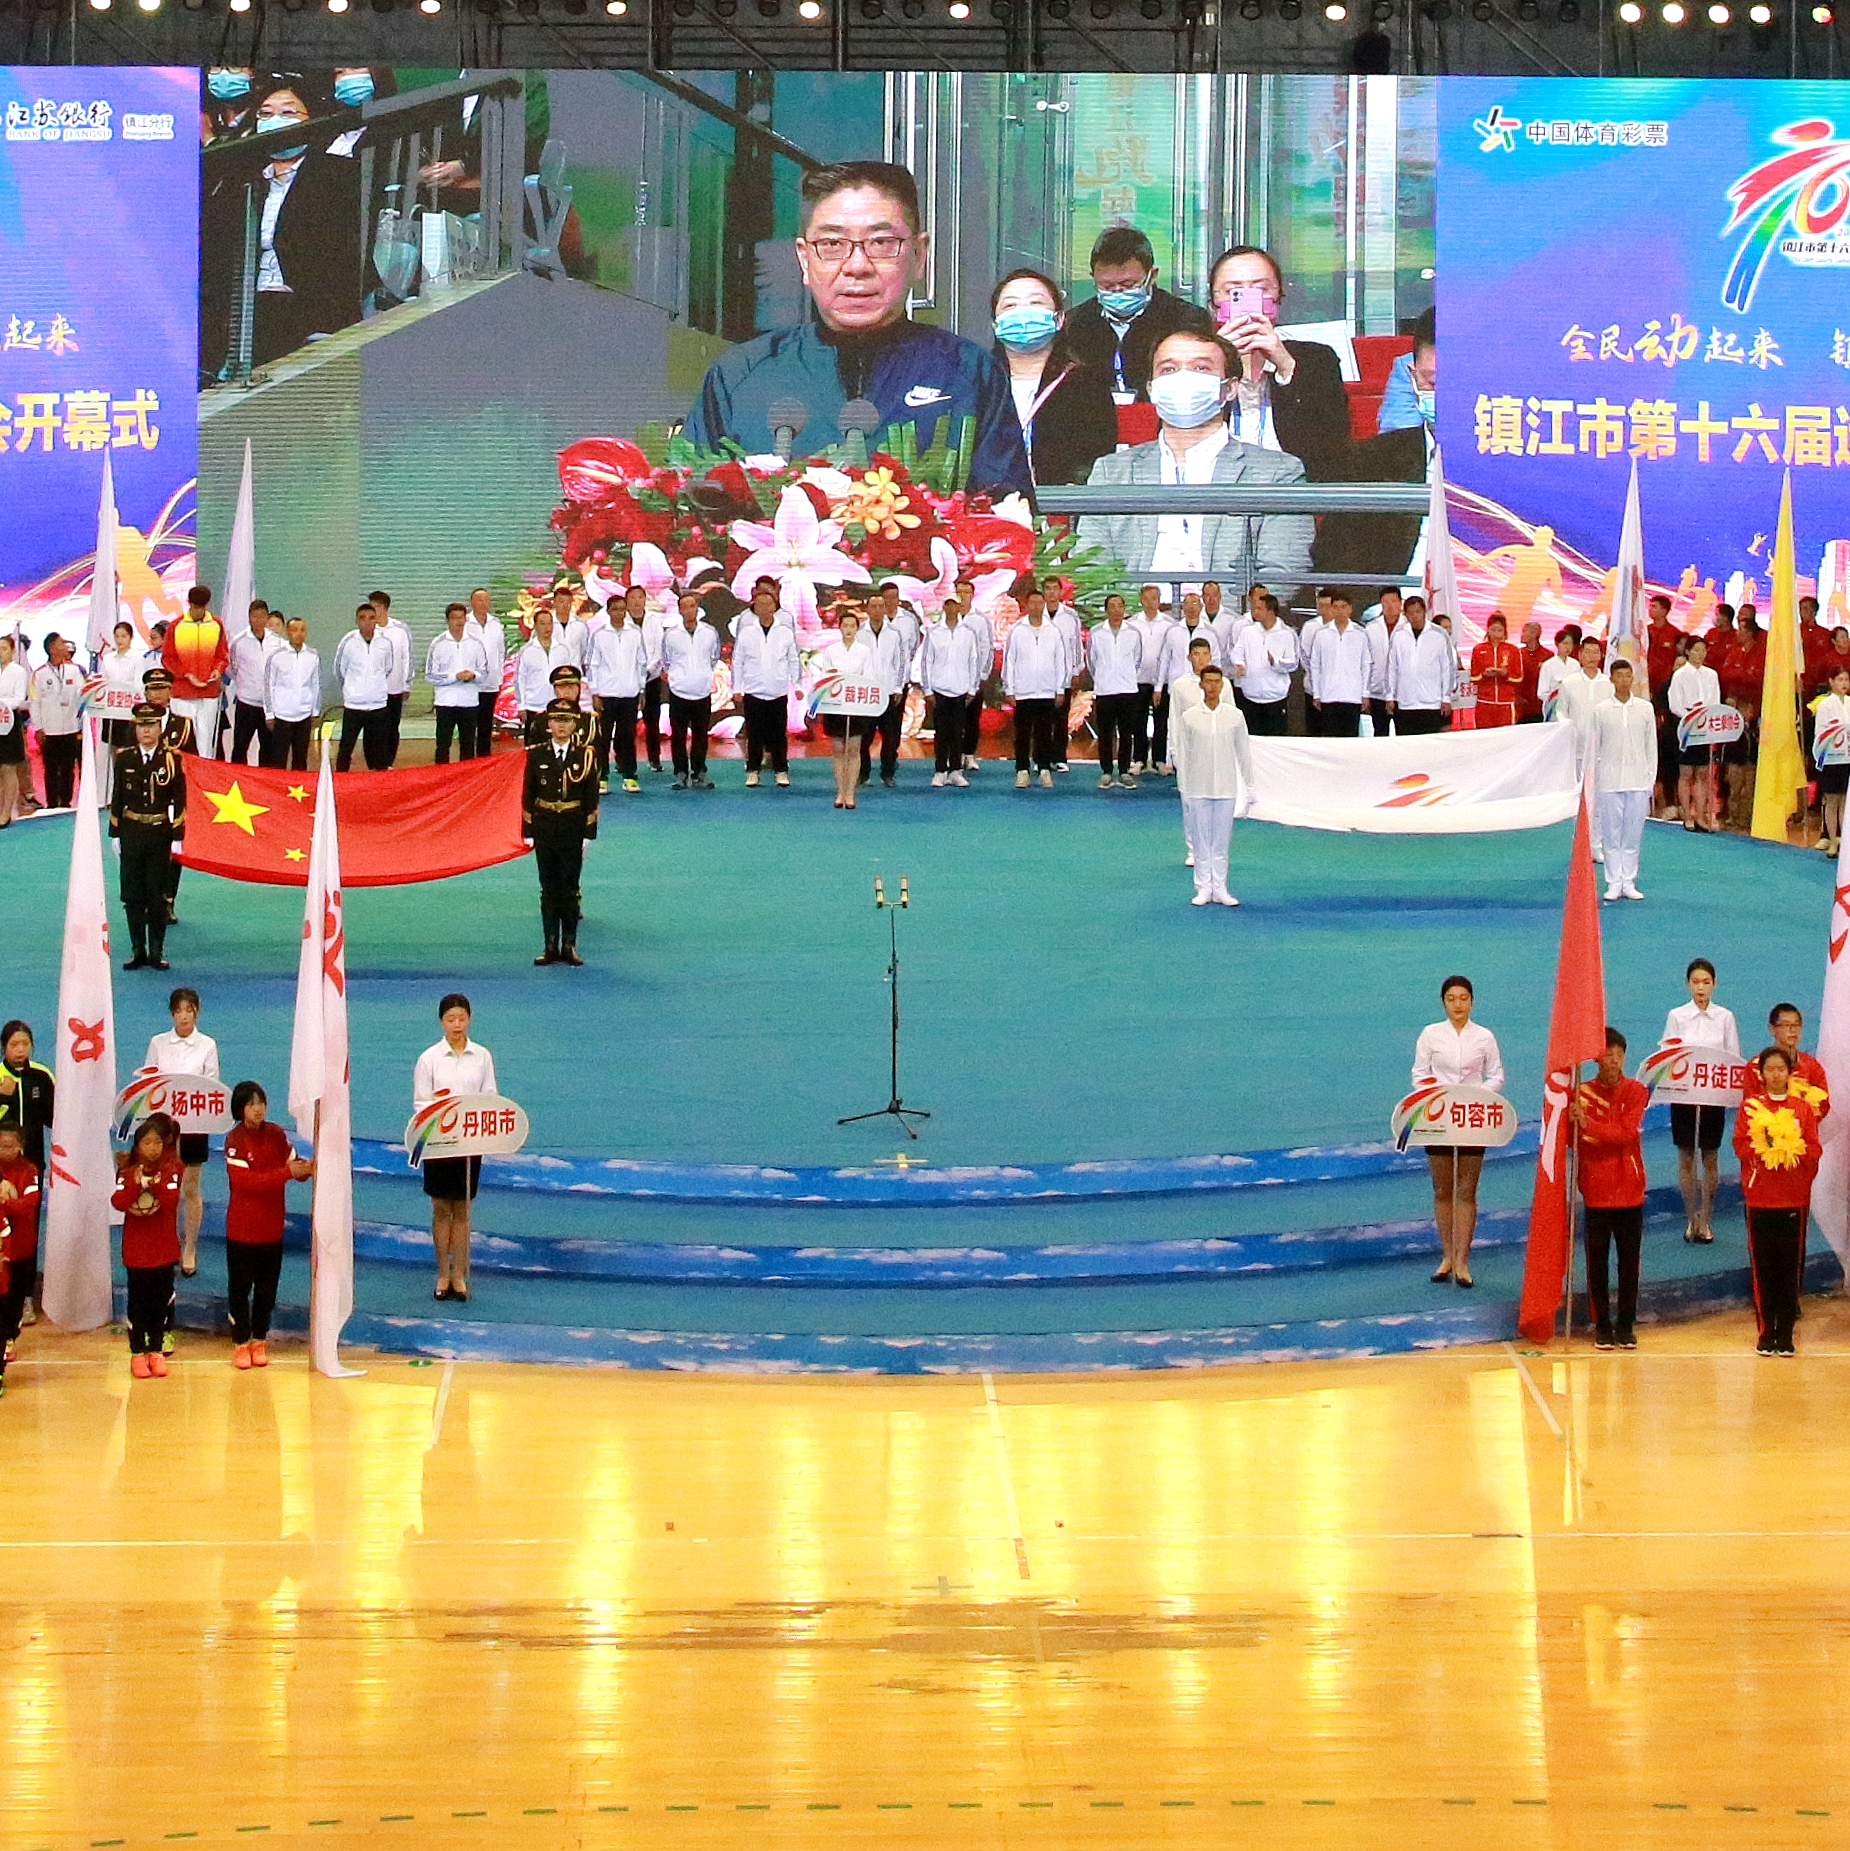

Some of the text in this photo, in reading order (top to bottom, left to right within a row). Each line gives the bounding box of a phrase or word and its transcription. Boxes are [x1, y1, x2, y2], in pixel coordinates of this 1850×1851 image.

[8, 100, 111, 127] 江苏银行
[1528, 122, 1665, 144] 中国体育彩票
[1559, 314, 1784, 371] 全民动起来
[845, 686, 880, 704] 裁判员
[1692, 1063, 1745, 1090] 丹徒区
[171, 1089, 225, 1118] 扬中市
[1449, 1101, 1504, 1130] 句容市
[462, 1108, 516, 1138] 丹阳市
